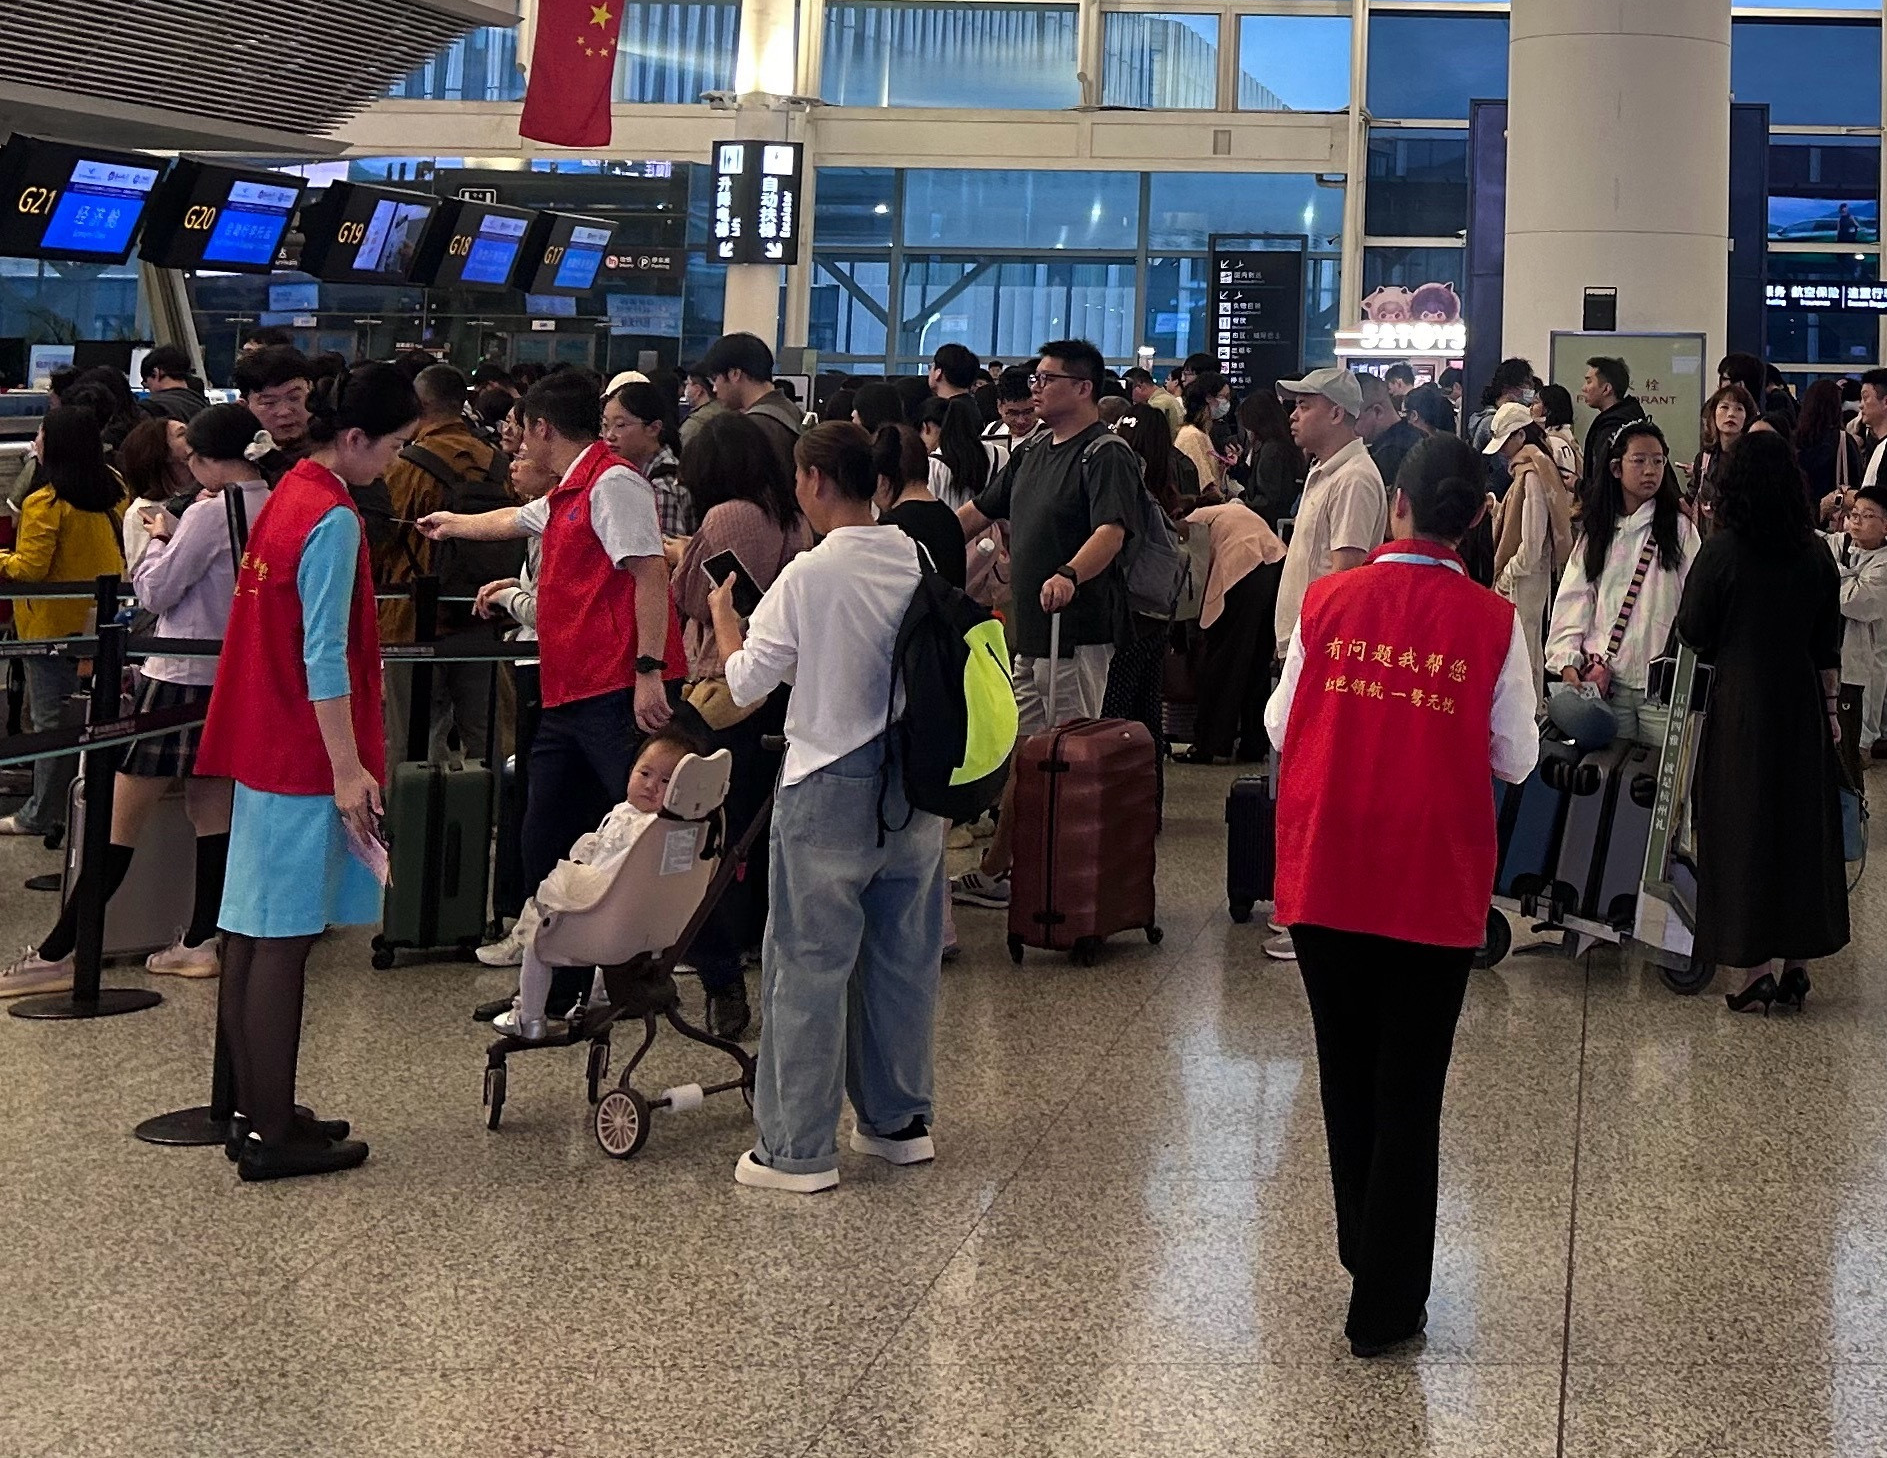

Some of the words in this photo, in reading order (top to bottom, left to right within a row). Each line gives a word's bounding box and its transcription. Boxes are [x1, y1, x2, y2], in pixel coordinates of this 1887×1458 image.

[19, 186, 57, 216] G21
[759, 175, 778, 238] 自动扶梯
[184, 205, 216, 230] G20
[338, 221, 365, 244] G19
[450, 235, 472, 256] G18
[544, 246, 564, 264] G17
[1325, 636, 1468, 683] 有问题我帮您
